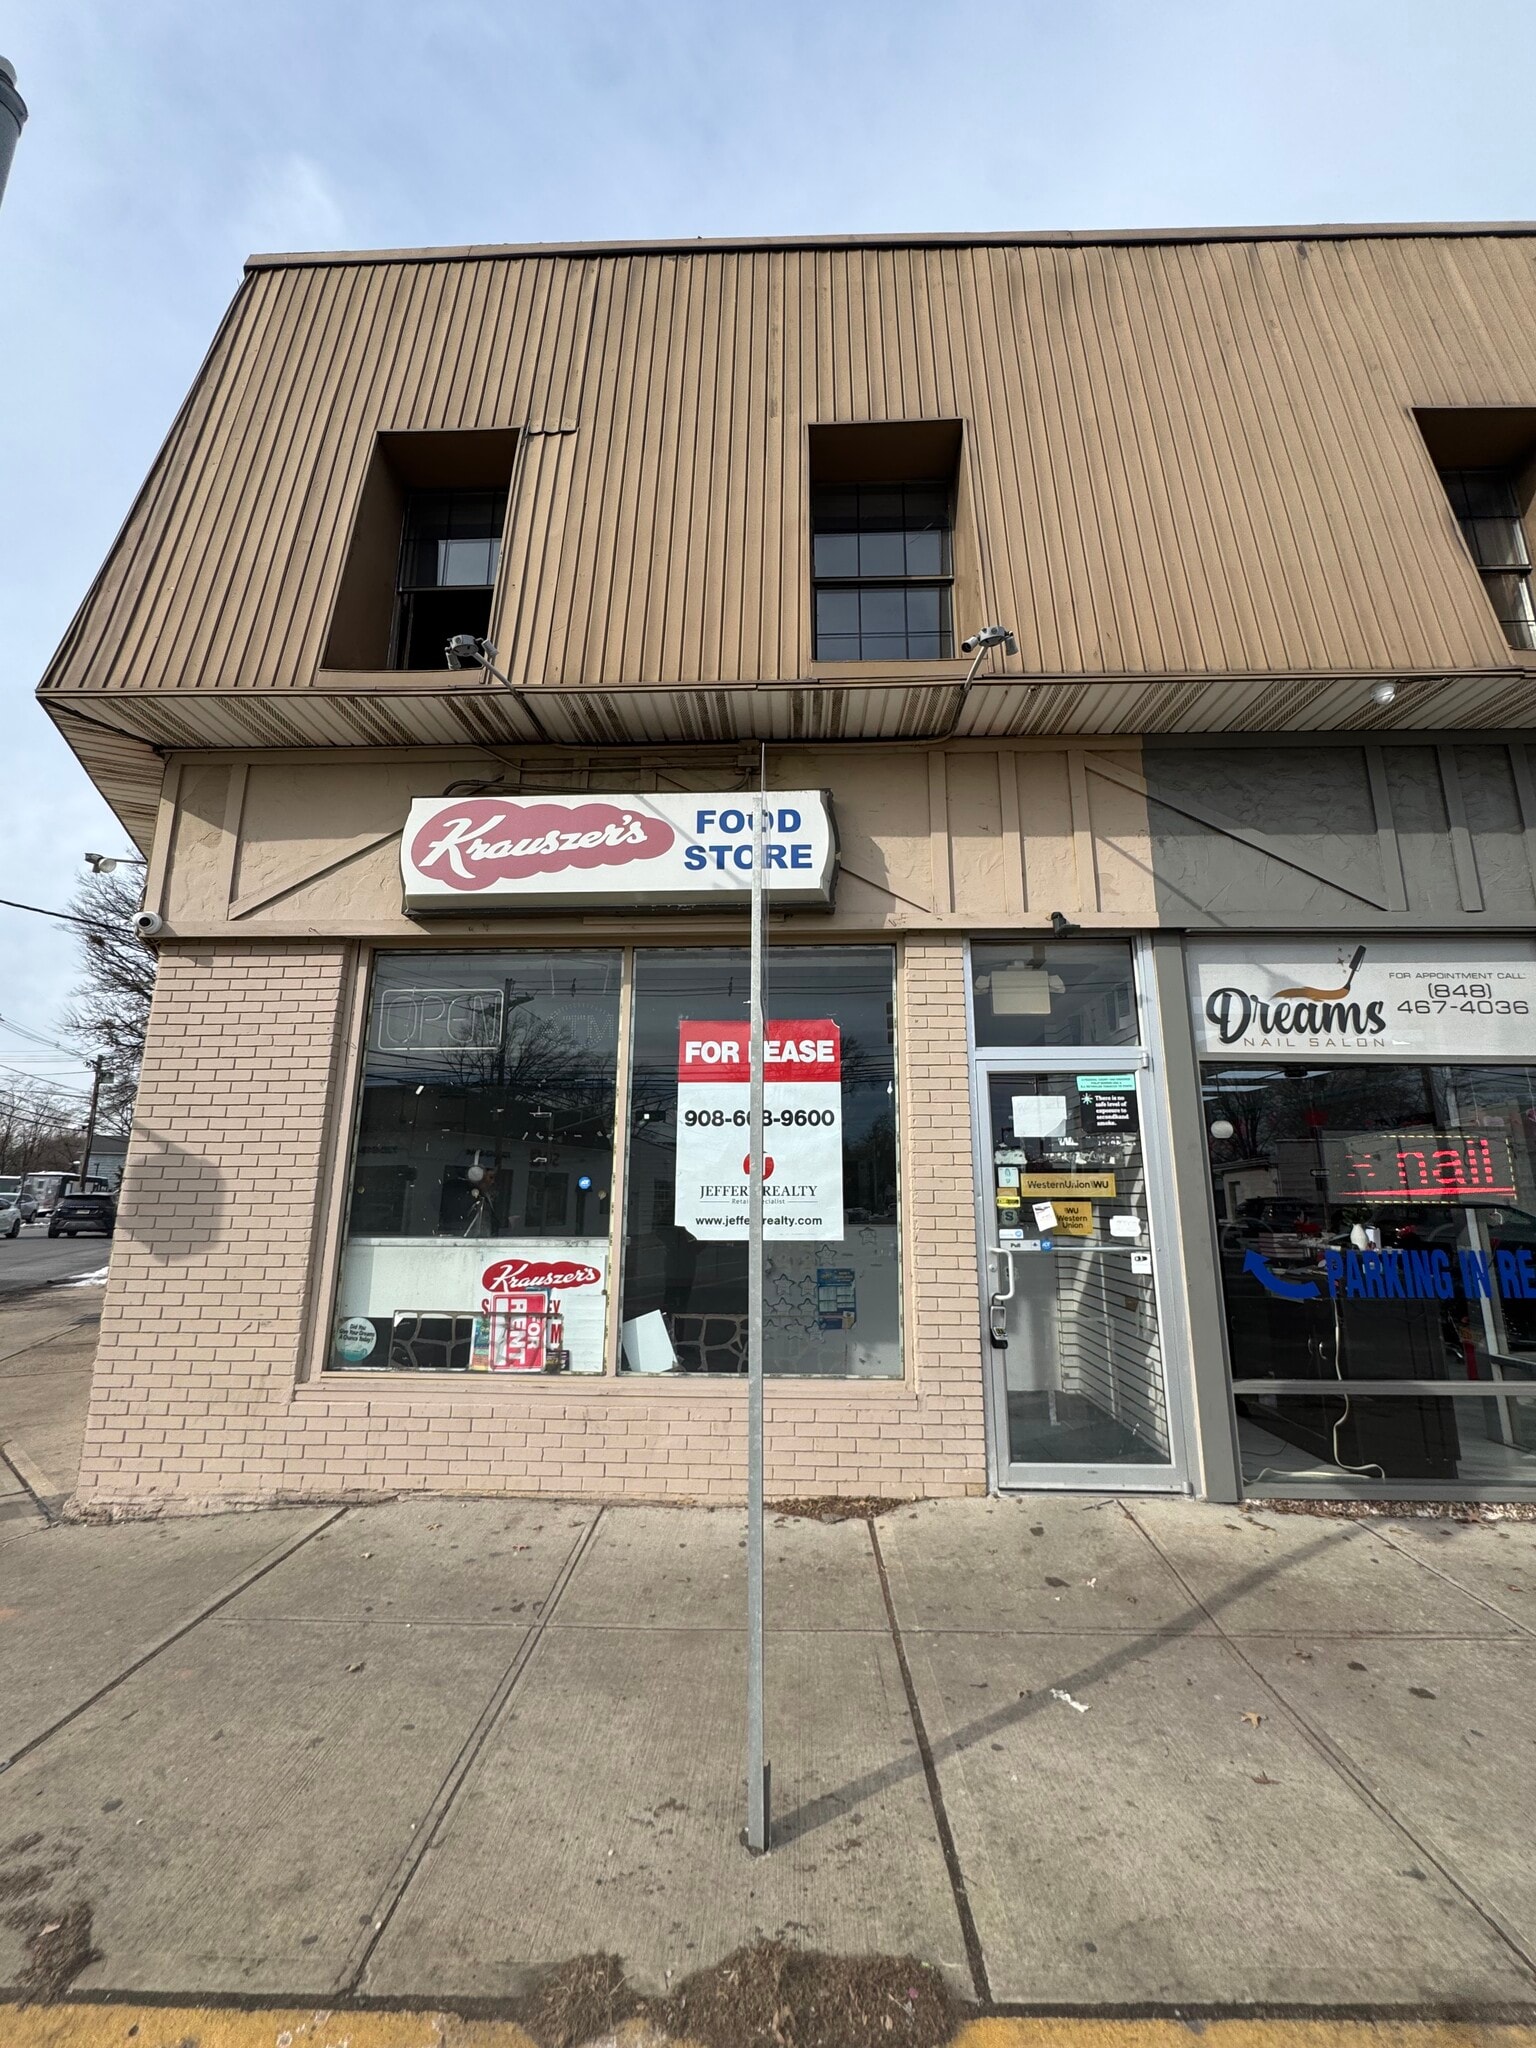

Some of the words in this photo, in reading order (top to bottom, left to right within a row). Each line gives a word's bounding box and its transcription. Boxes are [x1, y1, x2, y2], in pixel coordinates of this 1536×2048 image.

[418, 814, 648, 879] Krauszer's
[1428, 983, 1492, 999] (848)
[1206, 987, 1387, 1044] Dreams
[1397, 1000, 1529, 1014] 467-4036
[685, 1041, 740, 1064] FOR
[748, 1040, 835, 1063] EASE
[1244, 1038, 1295, 1047] NAIL
[1309, 1038, 1385, 1047] SALON
[684, 1110, 835, 1127] 908-68-9600
[1397, 1139, 1493, 1184] nail
[700, 1185, 751, 1199] JEFFER
[763, 1185, 818, 1197] REALTY
[1027, 1180, 1091, 1189] WesternUnion
[695, 1215, 822, 1227] www.jefferealty.com
[489, 1264, 596, 1293] Krauszer's
[1325, 1249, 1454, 1300] PARKING
[1459, 1249, 1492, 1299] IN
[509, 1298, 528, 1364] RENT
